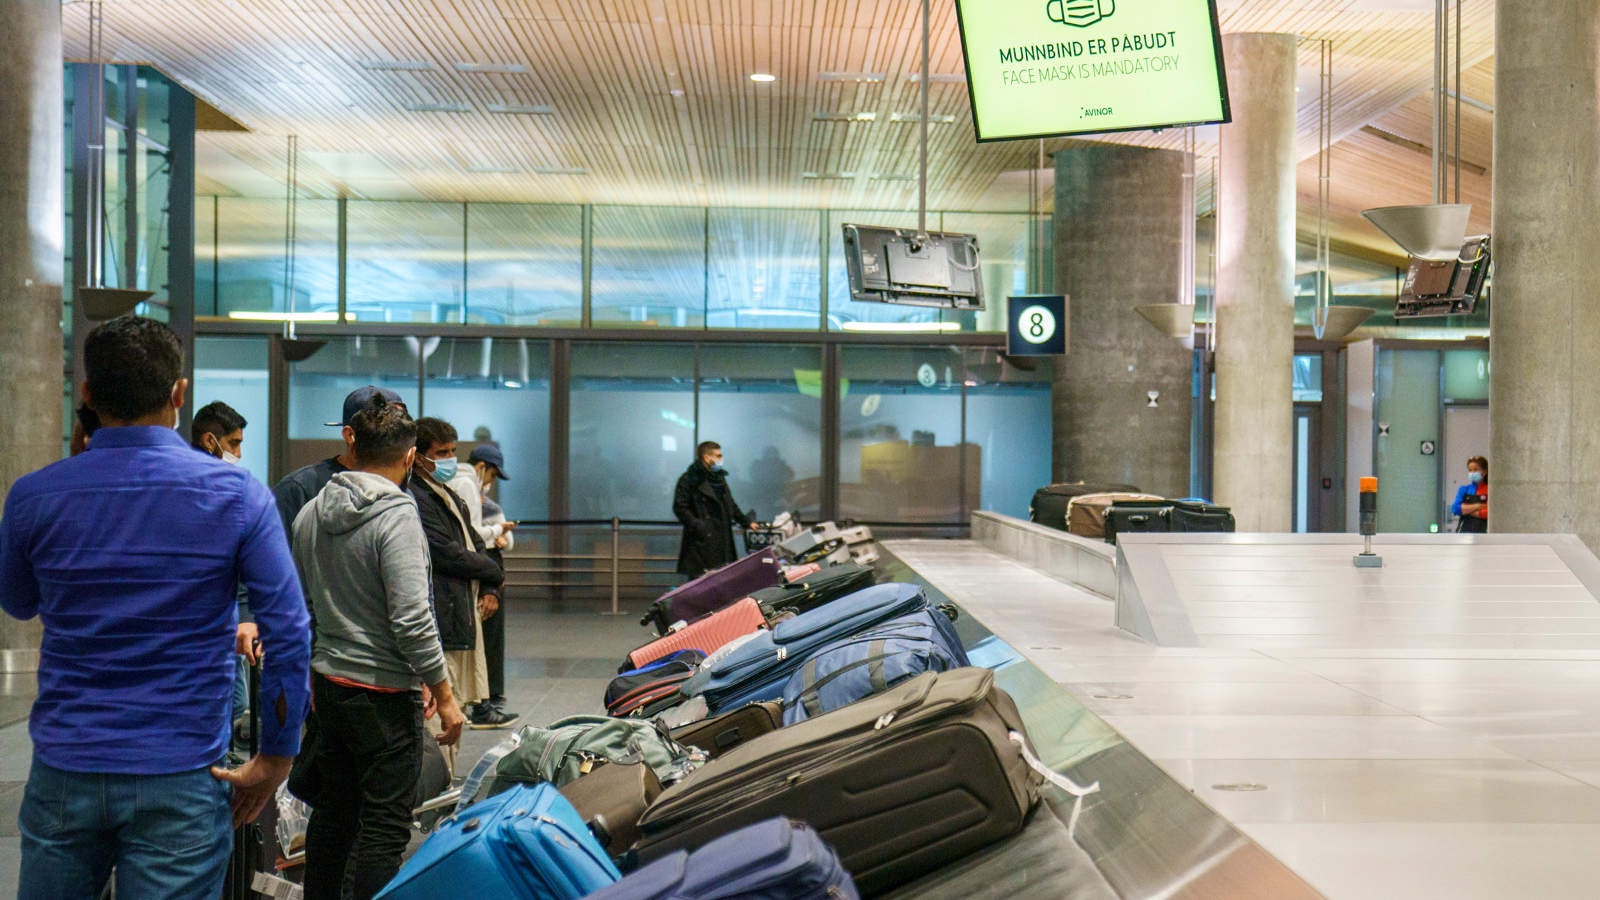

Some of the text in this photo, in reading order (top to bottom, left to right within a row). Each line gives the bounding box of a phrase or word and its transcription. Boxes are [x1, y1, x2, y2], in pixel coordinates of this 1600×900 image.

[999, 31, 1176, 64] MUNNBIND ER PÅBUDT
[1002, 54, 1180, 86] FACE MASK IS MANDATORY
[1084, 107, 1113, 117] AVINOR
[1030, 312, 1044, 337] 8
